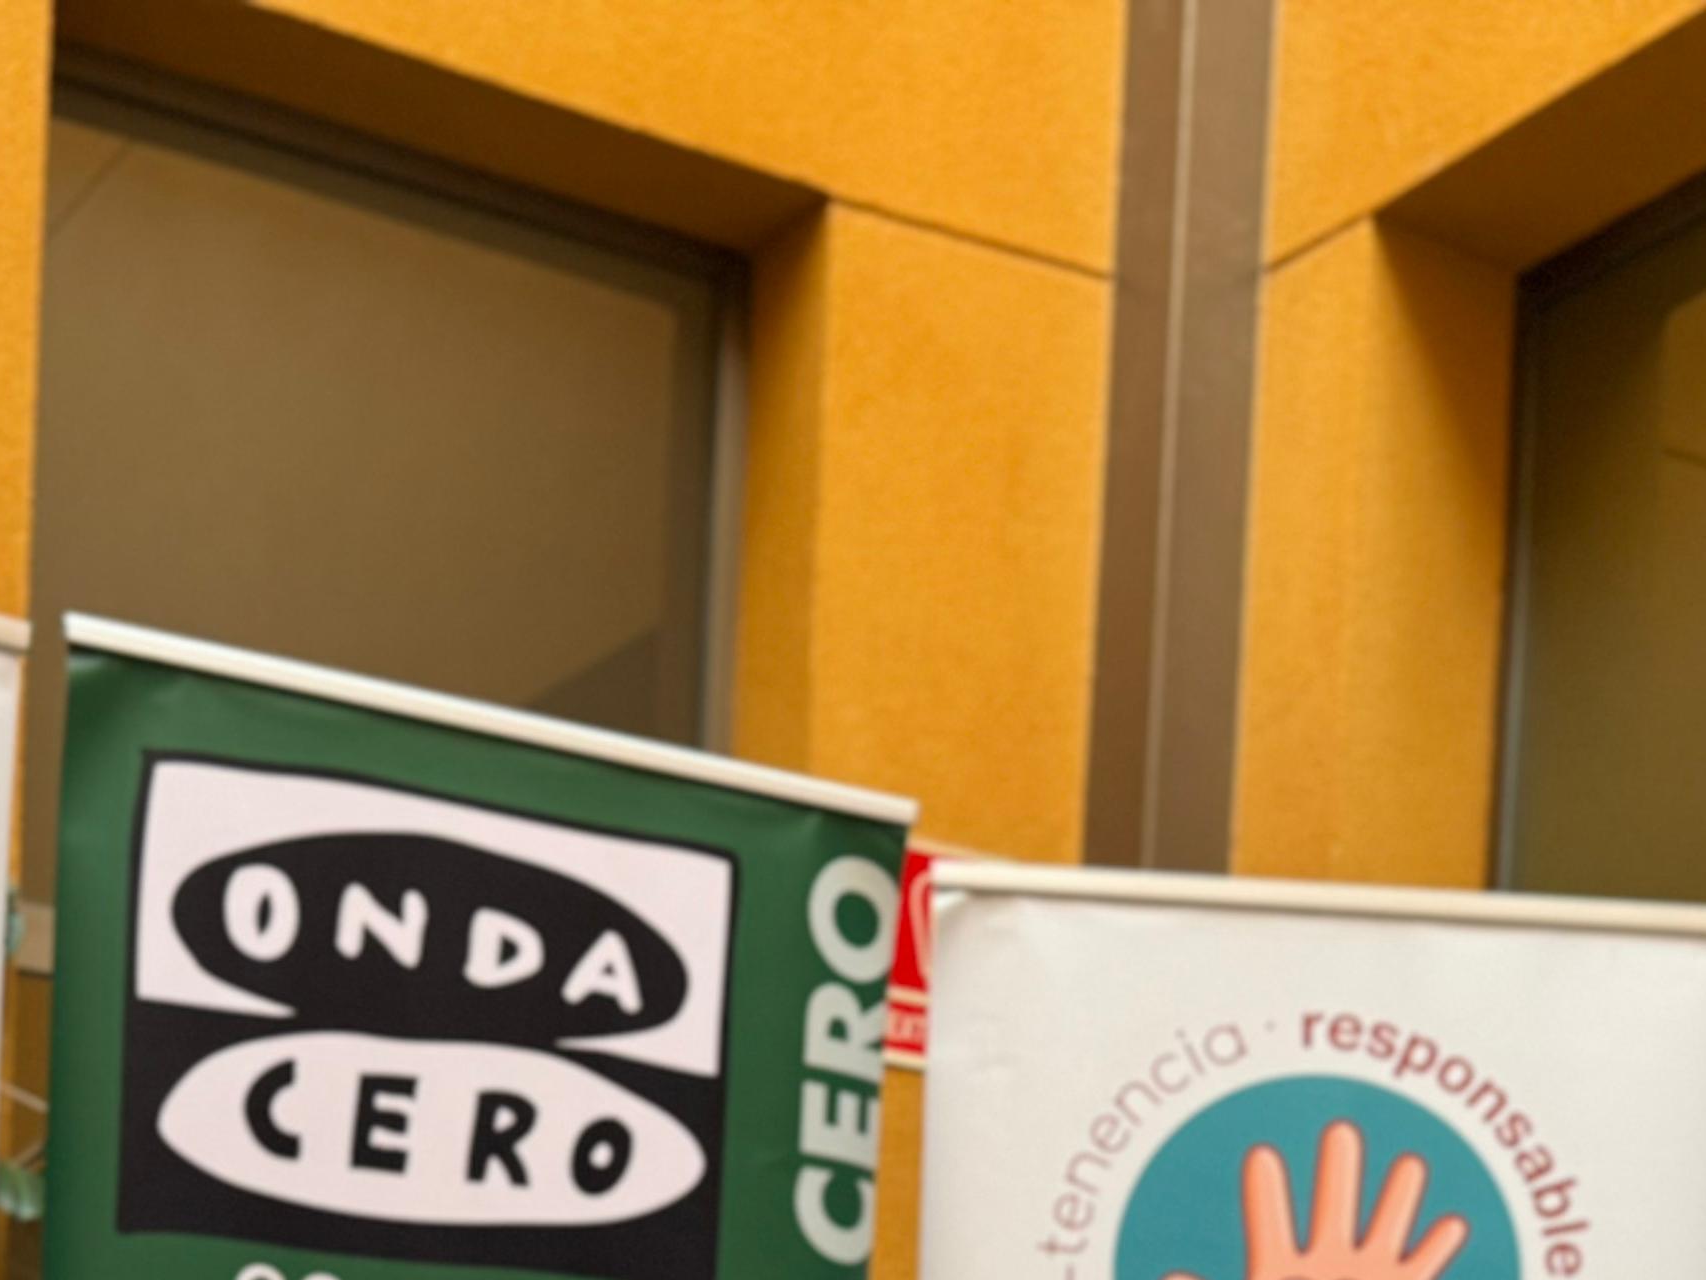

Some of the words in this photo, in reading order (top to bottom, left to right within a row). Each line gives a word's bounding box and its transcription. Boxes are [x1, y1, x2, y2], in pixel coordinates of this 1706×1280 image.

[224, 863, 643, 1015] ONDA
[244, 1058, 633, 1195] CERO
[793, 855, 901, 1268] CERO
[1037, 1022, 1249, 1256] tenencia
[1302, 1012, 1591, 1278] responsable
